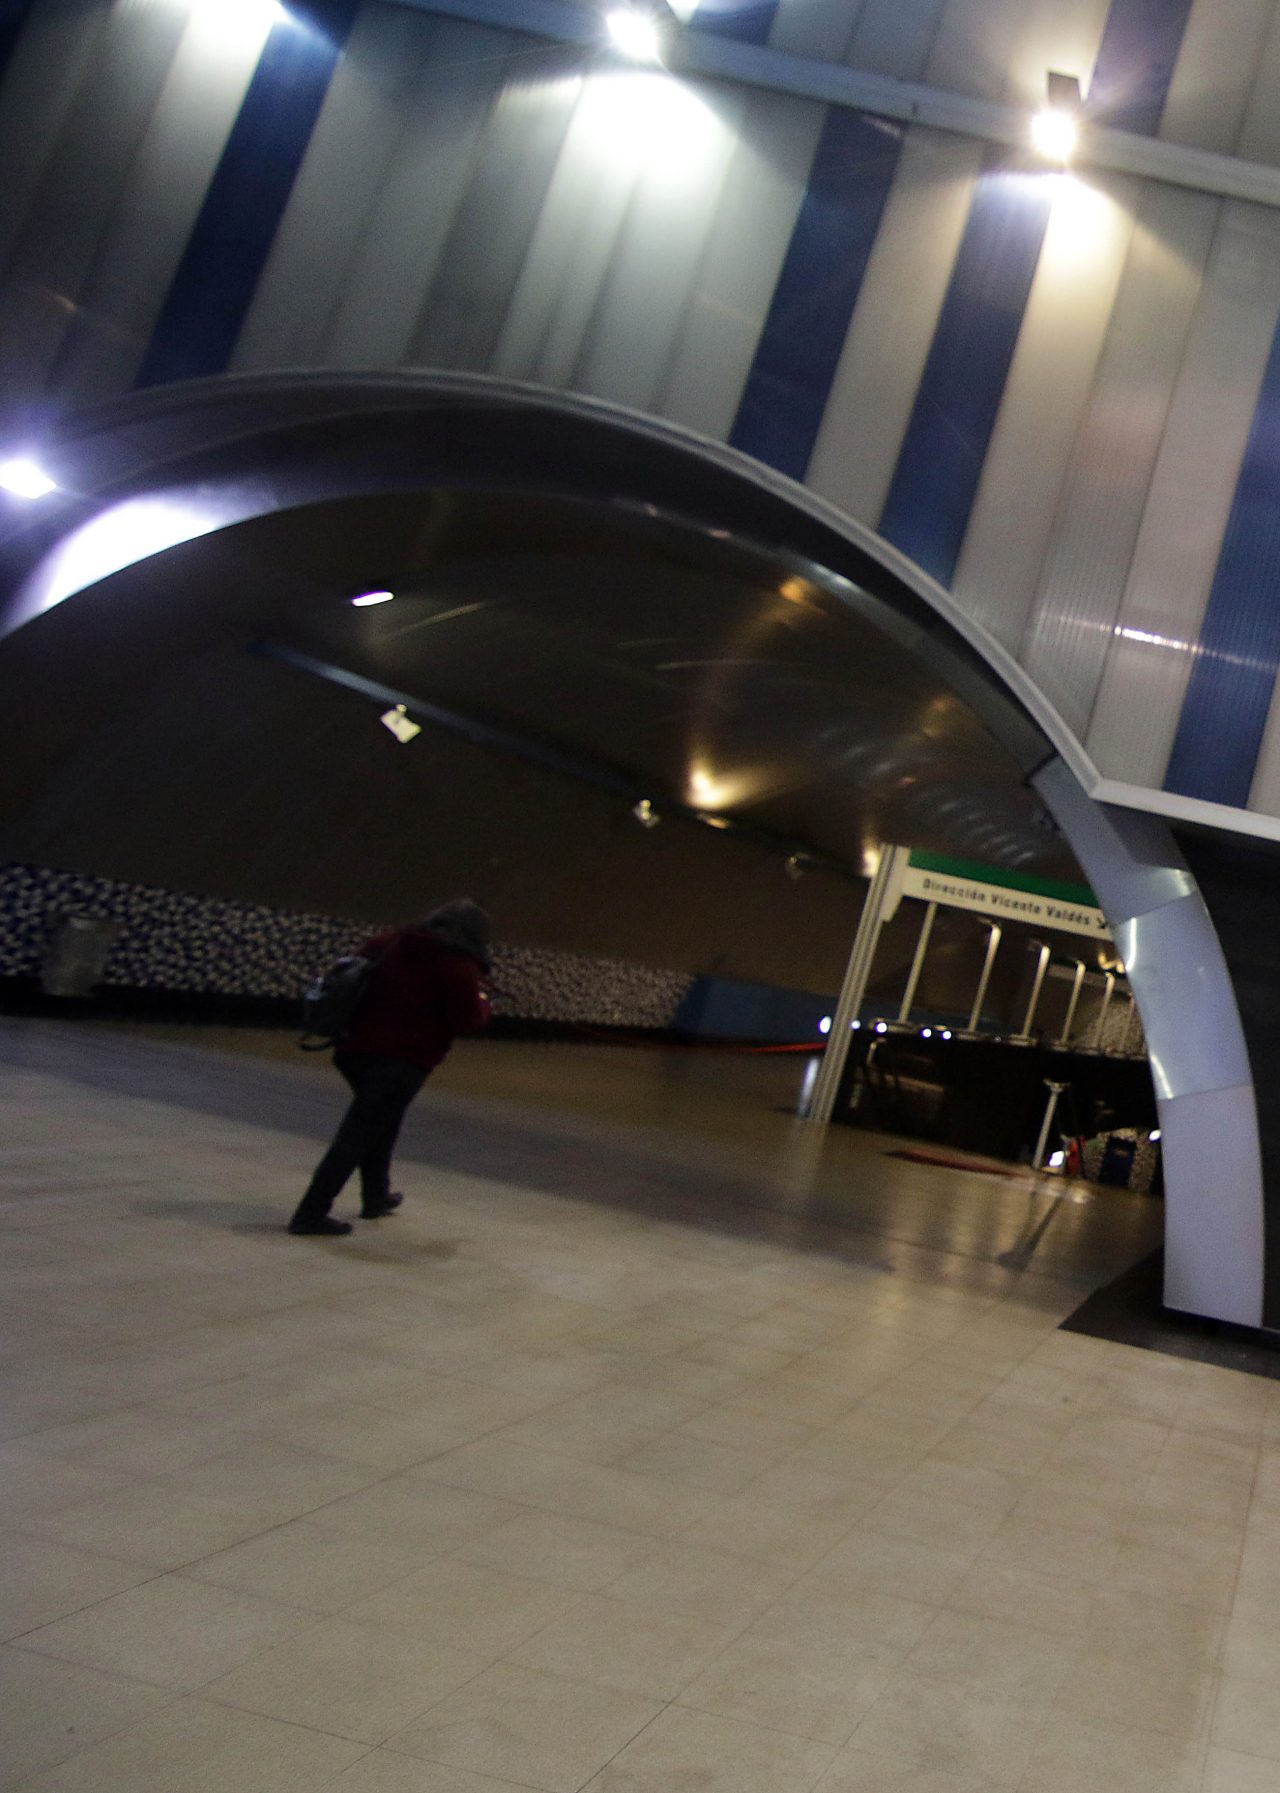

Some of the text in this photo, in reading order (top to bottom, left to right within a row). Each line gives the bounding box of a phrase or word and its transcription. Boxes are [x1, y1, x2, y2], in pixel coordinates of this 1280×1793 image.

[922, 878, 1090, 926] Dirección Vicente Valdés
